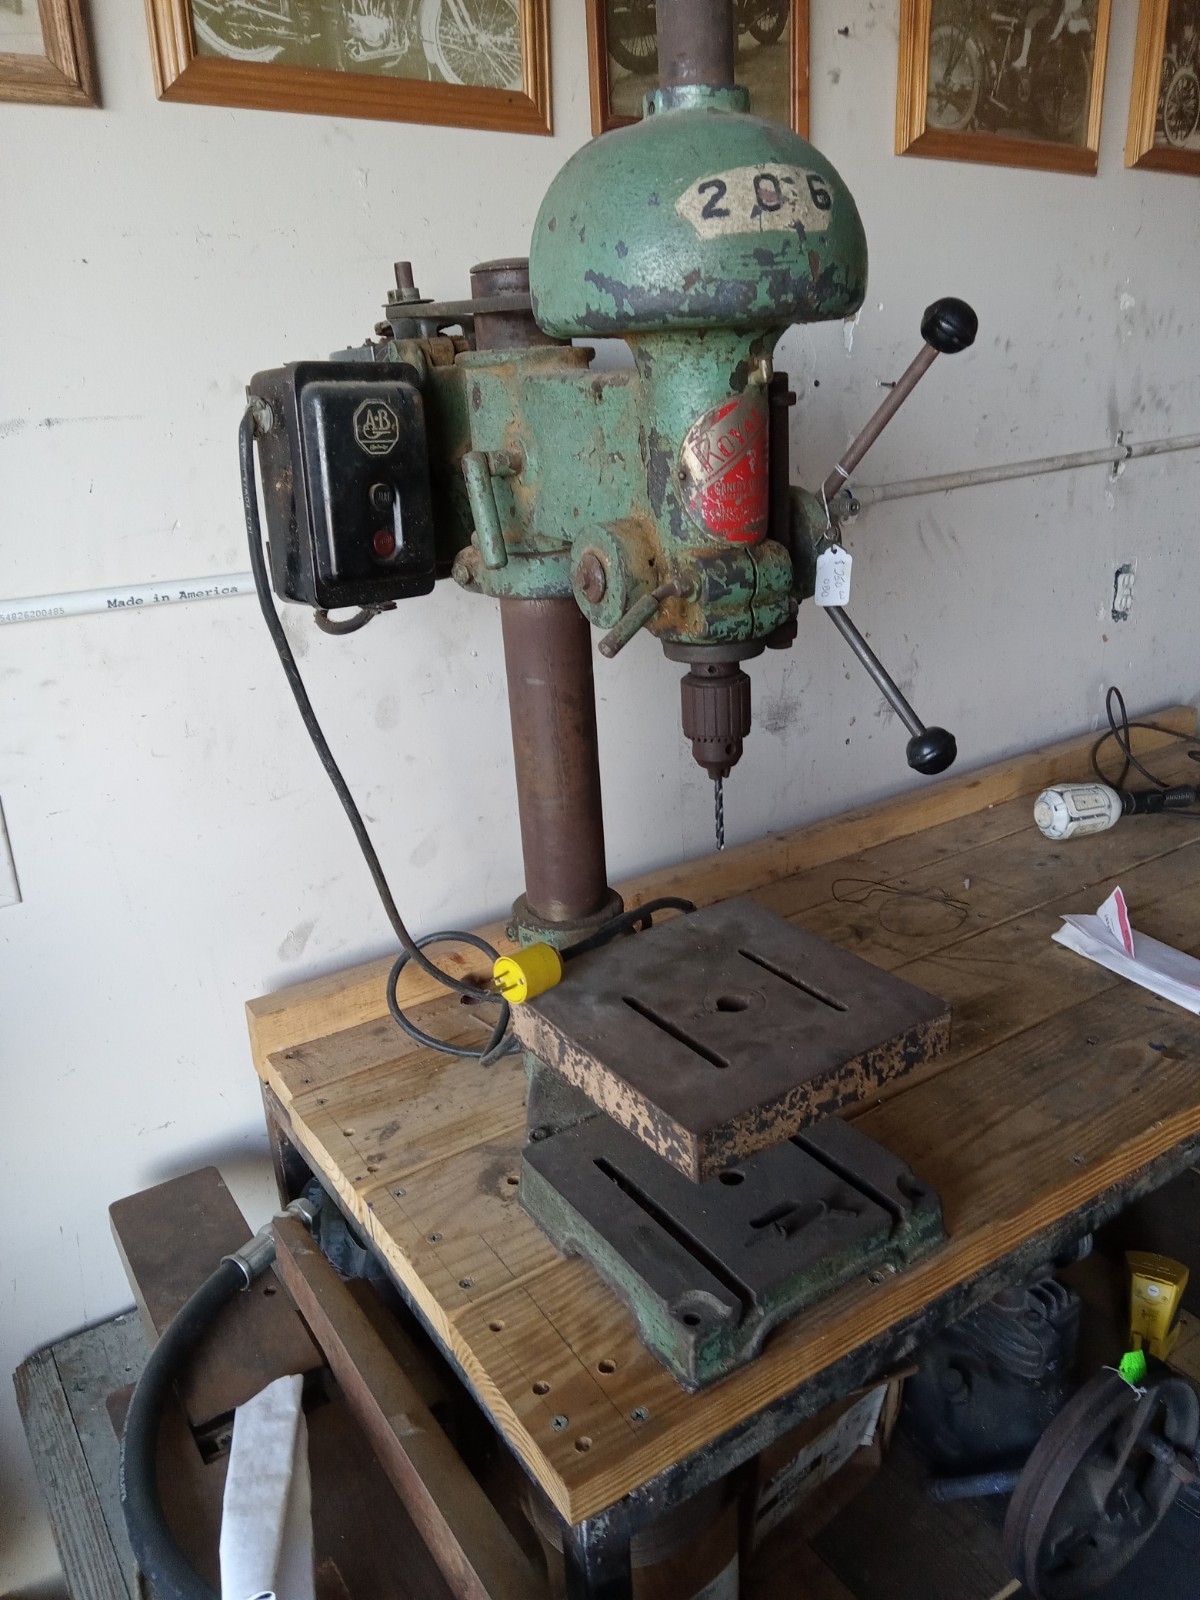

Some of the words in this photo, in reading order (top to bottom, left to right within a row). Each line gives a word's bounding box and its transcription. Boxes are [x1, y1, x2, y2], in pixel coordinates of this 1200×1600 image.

[107, 596, 144, 609] Made
[153, 593, 170, 604] in
[179, 585, 239, 600] America
